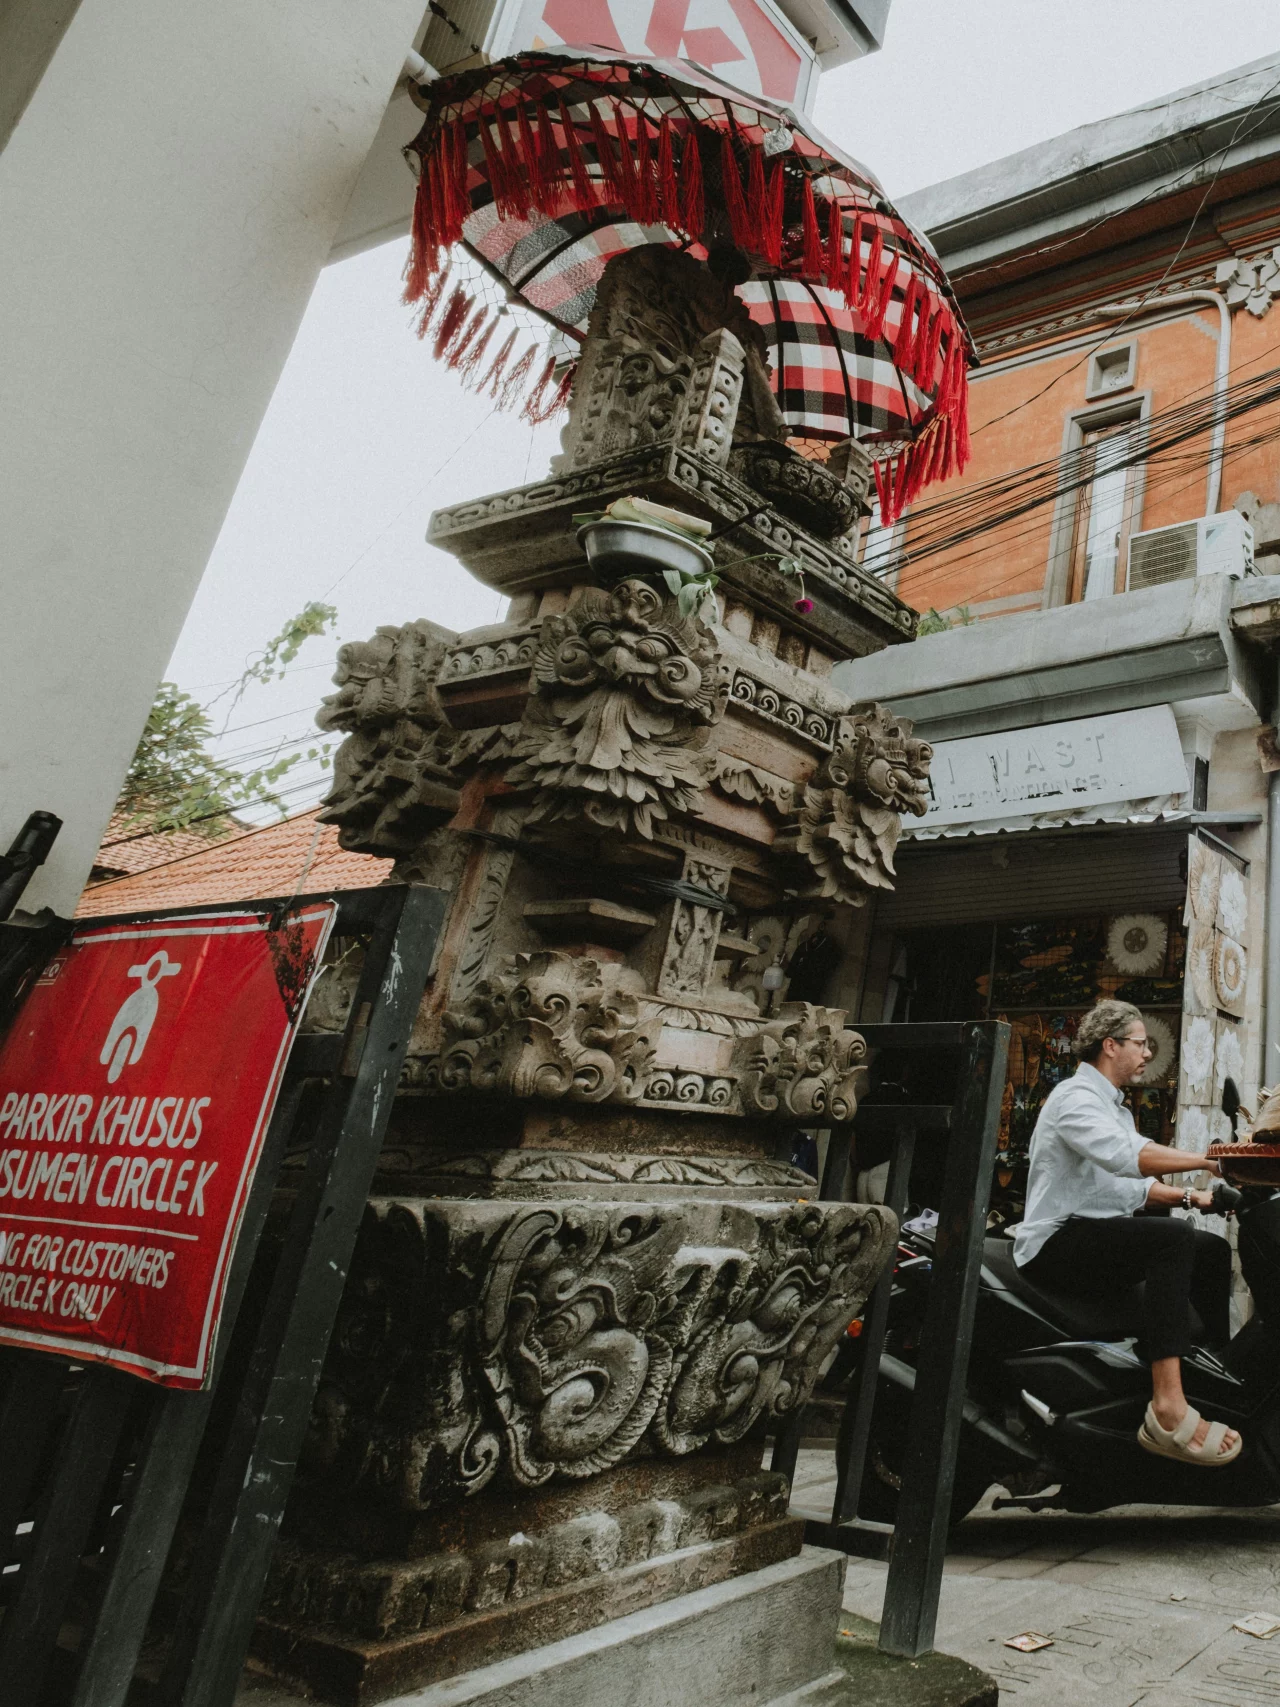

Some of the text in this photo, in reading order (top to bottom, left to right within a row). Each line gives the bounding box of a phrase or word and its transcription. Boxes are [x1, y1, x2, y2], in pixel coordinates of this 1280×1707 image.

[0, 1092, 211, 1149] PARKIR KHUSUS
[0, 1149, 219, 1217] SUMEN CIRCLE K
[21, 1233, 64, 1272] FOR
[61, 1238, 175, 1289] CUSTOMERS
[42, 1278, 63, 1314] K
[60, 1281, 116, 1322] ONLY
